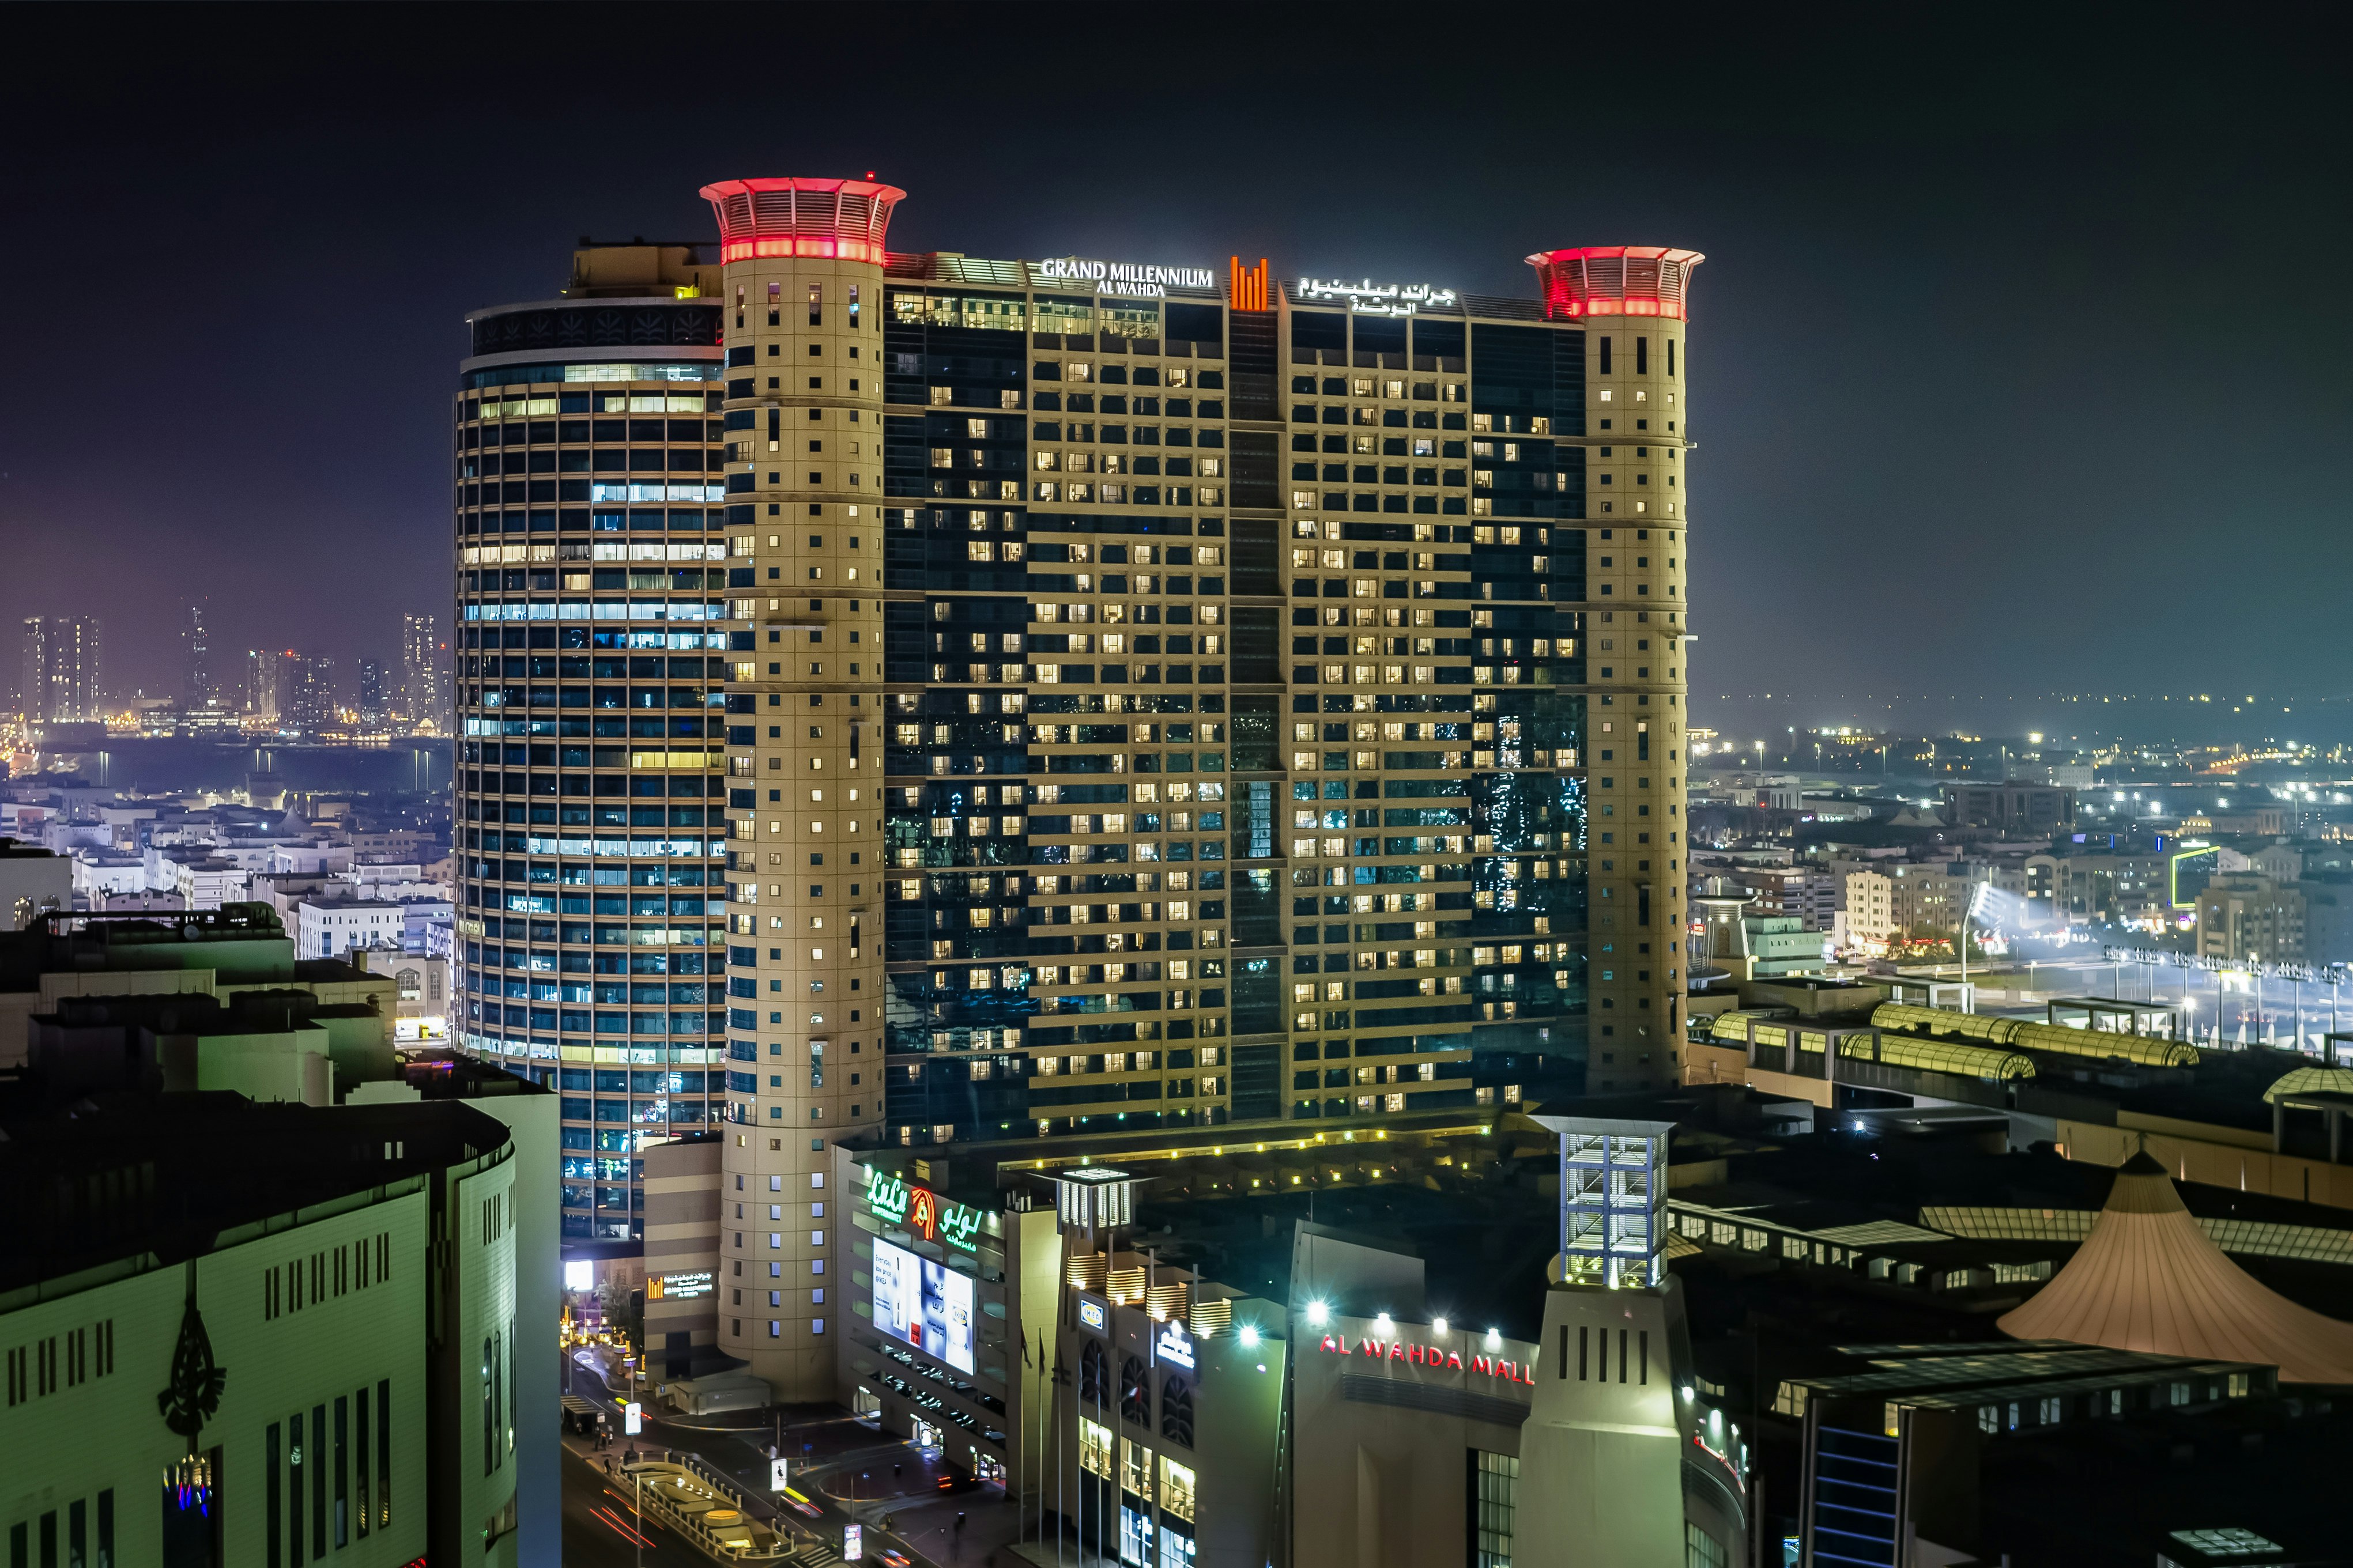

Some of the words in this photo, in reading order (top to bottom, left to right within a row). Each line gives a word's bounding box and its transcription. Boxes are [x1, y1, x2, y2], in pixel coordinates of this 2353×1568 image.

[1041, 259, 1106, 279] GRAND
[1110, 262, 1213, 288] MILLENNIUM
[1096, 280, 1114, 294] AL
[1116, 281, 1166, 298] WAHDA
[1299, 277, 1398, 303] ميلينيوم
[1400, 284, 1456, 306] جراند
[1352, 298, 1417, 318] الوحدة
[939, 1204, 983, 1240] لولو
[1084, 1308, 1100, 1321] IKEA
[1319, 1334, 1352, 1355] AL
[1362, 1337, 1463, 1370] WAHDA
[1472, 1354, 1536, 1385] MALL
